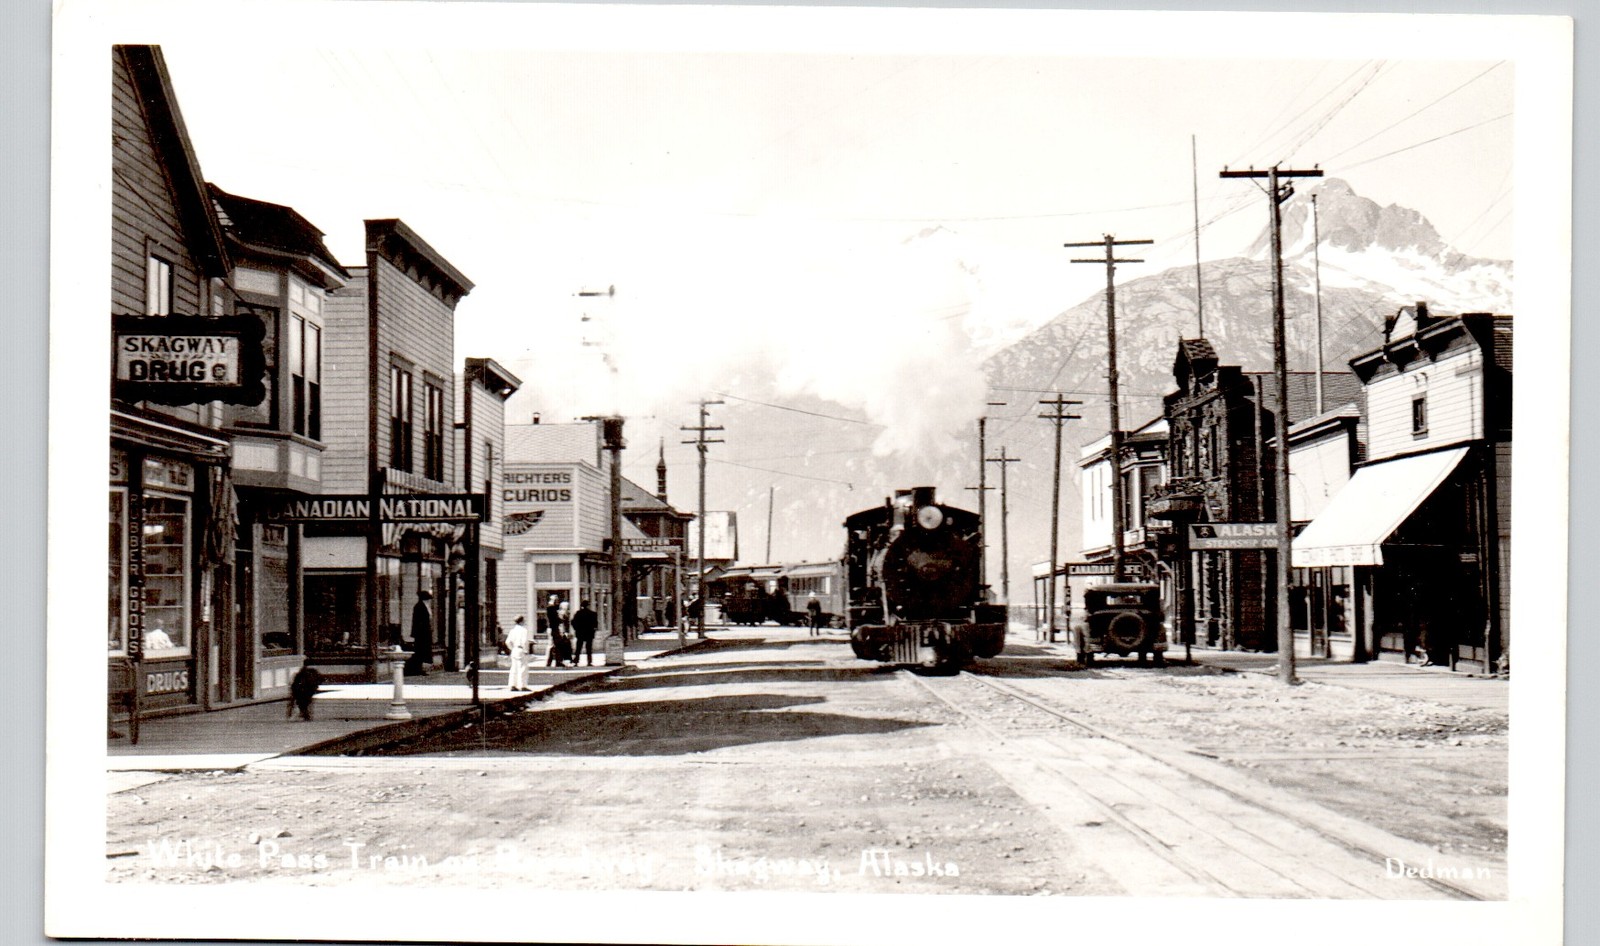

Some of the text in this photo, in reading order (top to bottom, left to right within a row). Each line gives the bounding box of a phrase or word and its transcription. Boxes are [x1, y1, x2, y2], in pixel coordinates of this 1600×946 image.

[124, 338, 227, 353] SKAGWAY
[128, 359, 206, 381] DRUG
[503, 489, 571, 502] CURIOS
[379, 498, 479, 519] NATIONAL
[1219, 525, 1278, 537] ALASK
[130, 495, 139, 653] RUBBER GOODS
[147, 670, 188, 692] DRUGS
